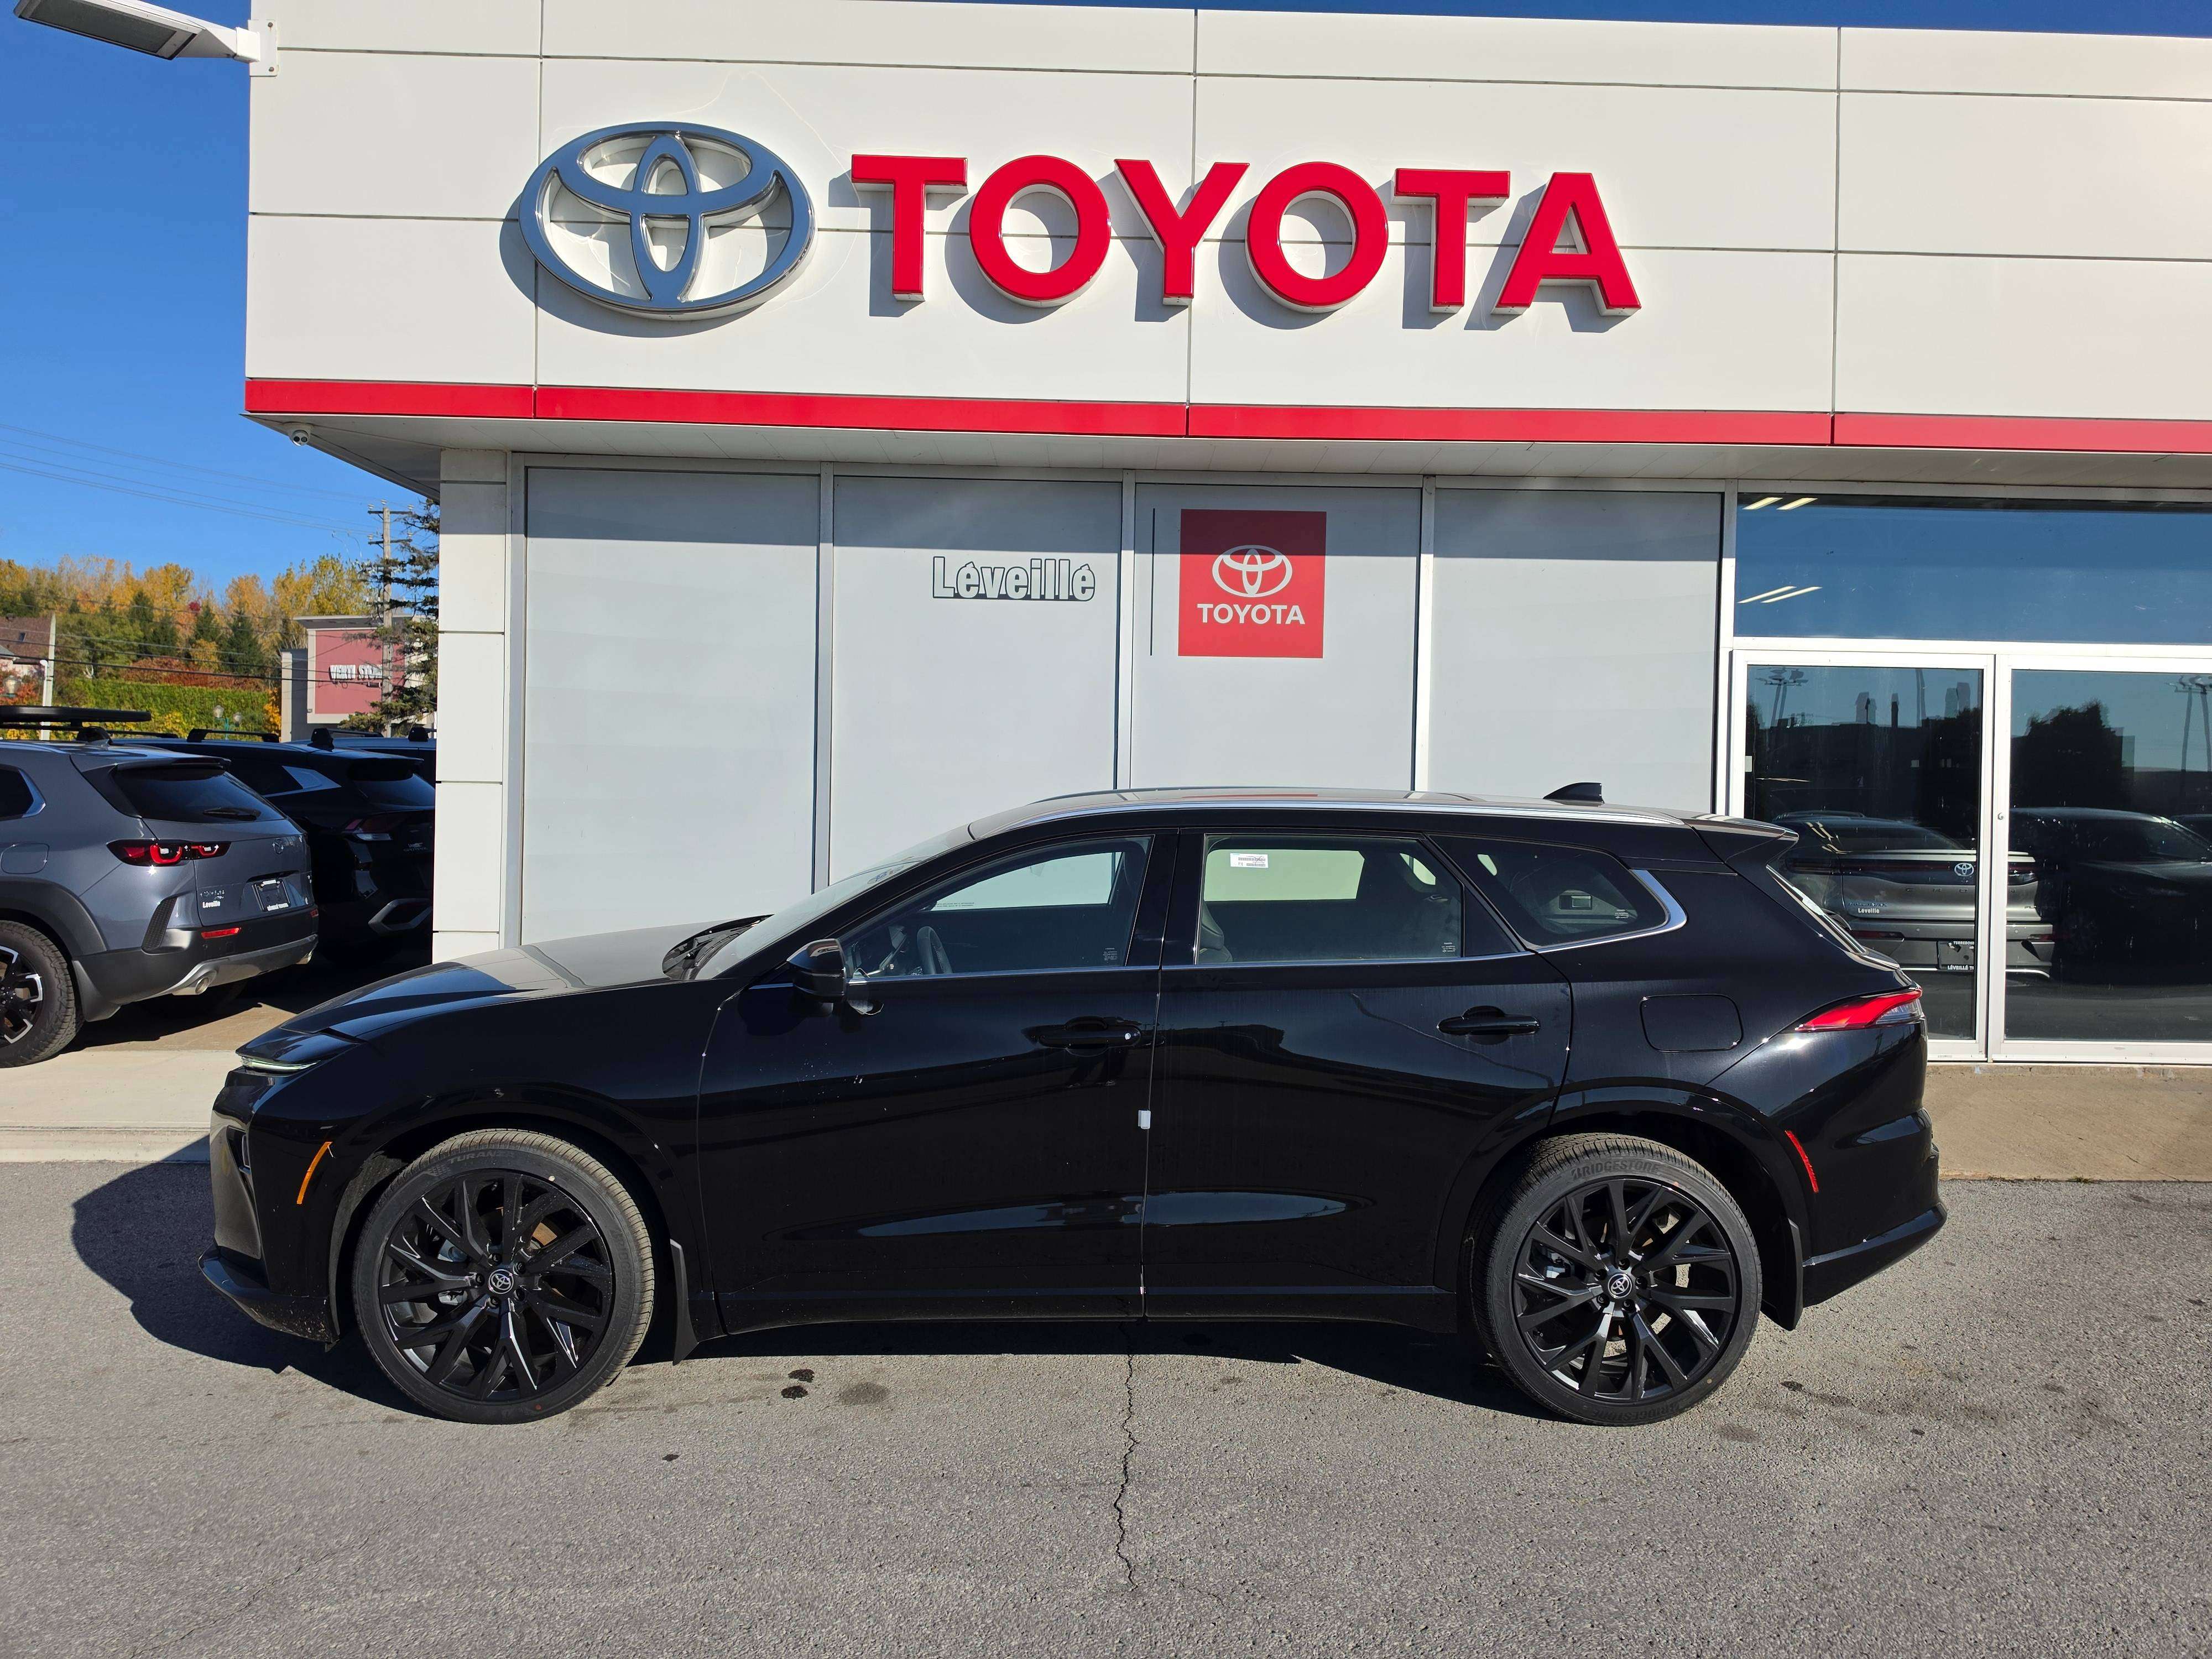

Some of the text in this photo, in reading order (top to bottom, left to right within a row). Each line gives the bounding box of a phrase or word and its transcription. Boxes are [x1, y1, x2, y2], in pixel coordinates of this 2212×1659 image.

[851, 154, 1641, 315] TOYOTA
[933, 555, 1095, 601] Léveillé
[1197, 603, 1306, 624] TOYOTA
[1570, 1160, 1661, 1181] BRIDGESTONE
